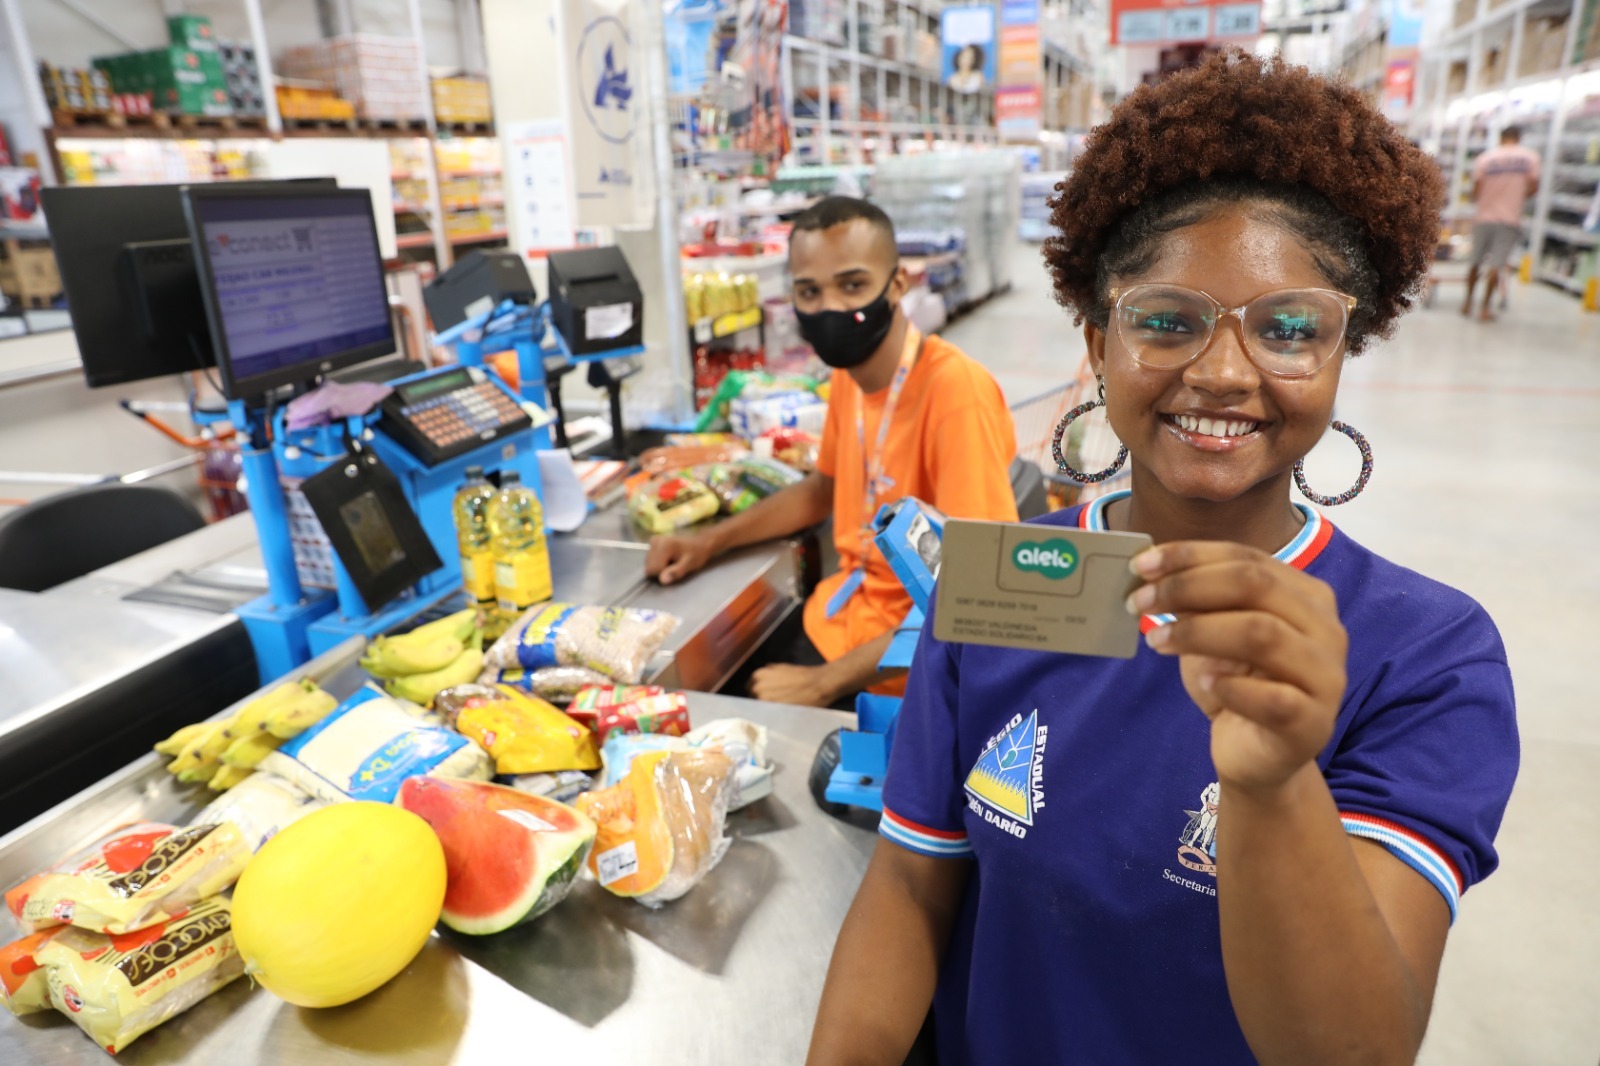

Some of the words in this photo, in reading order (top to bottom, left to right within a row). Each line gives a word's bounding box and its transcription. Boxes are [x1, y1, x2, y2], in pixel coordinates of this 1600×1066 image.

[1016, 546, 1074, 569] alelo
[1030, 724, 1048, 814] ESTADUAL
[984, 809, 1027, 840] DARÍO
[1162, 868, 1216, 896] Secretaria
[130, 911, 231, 981] EMOÇÕES
